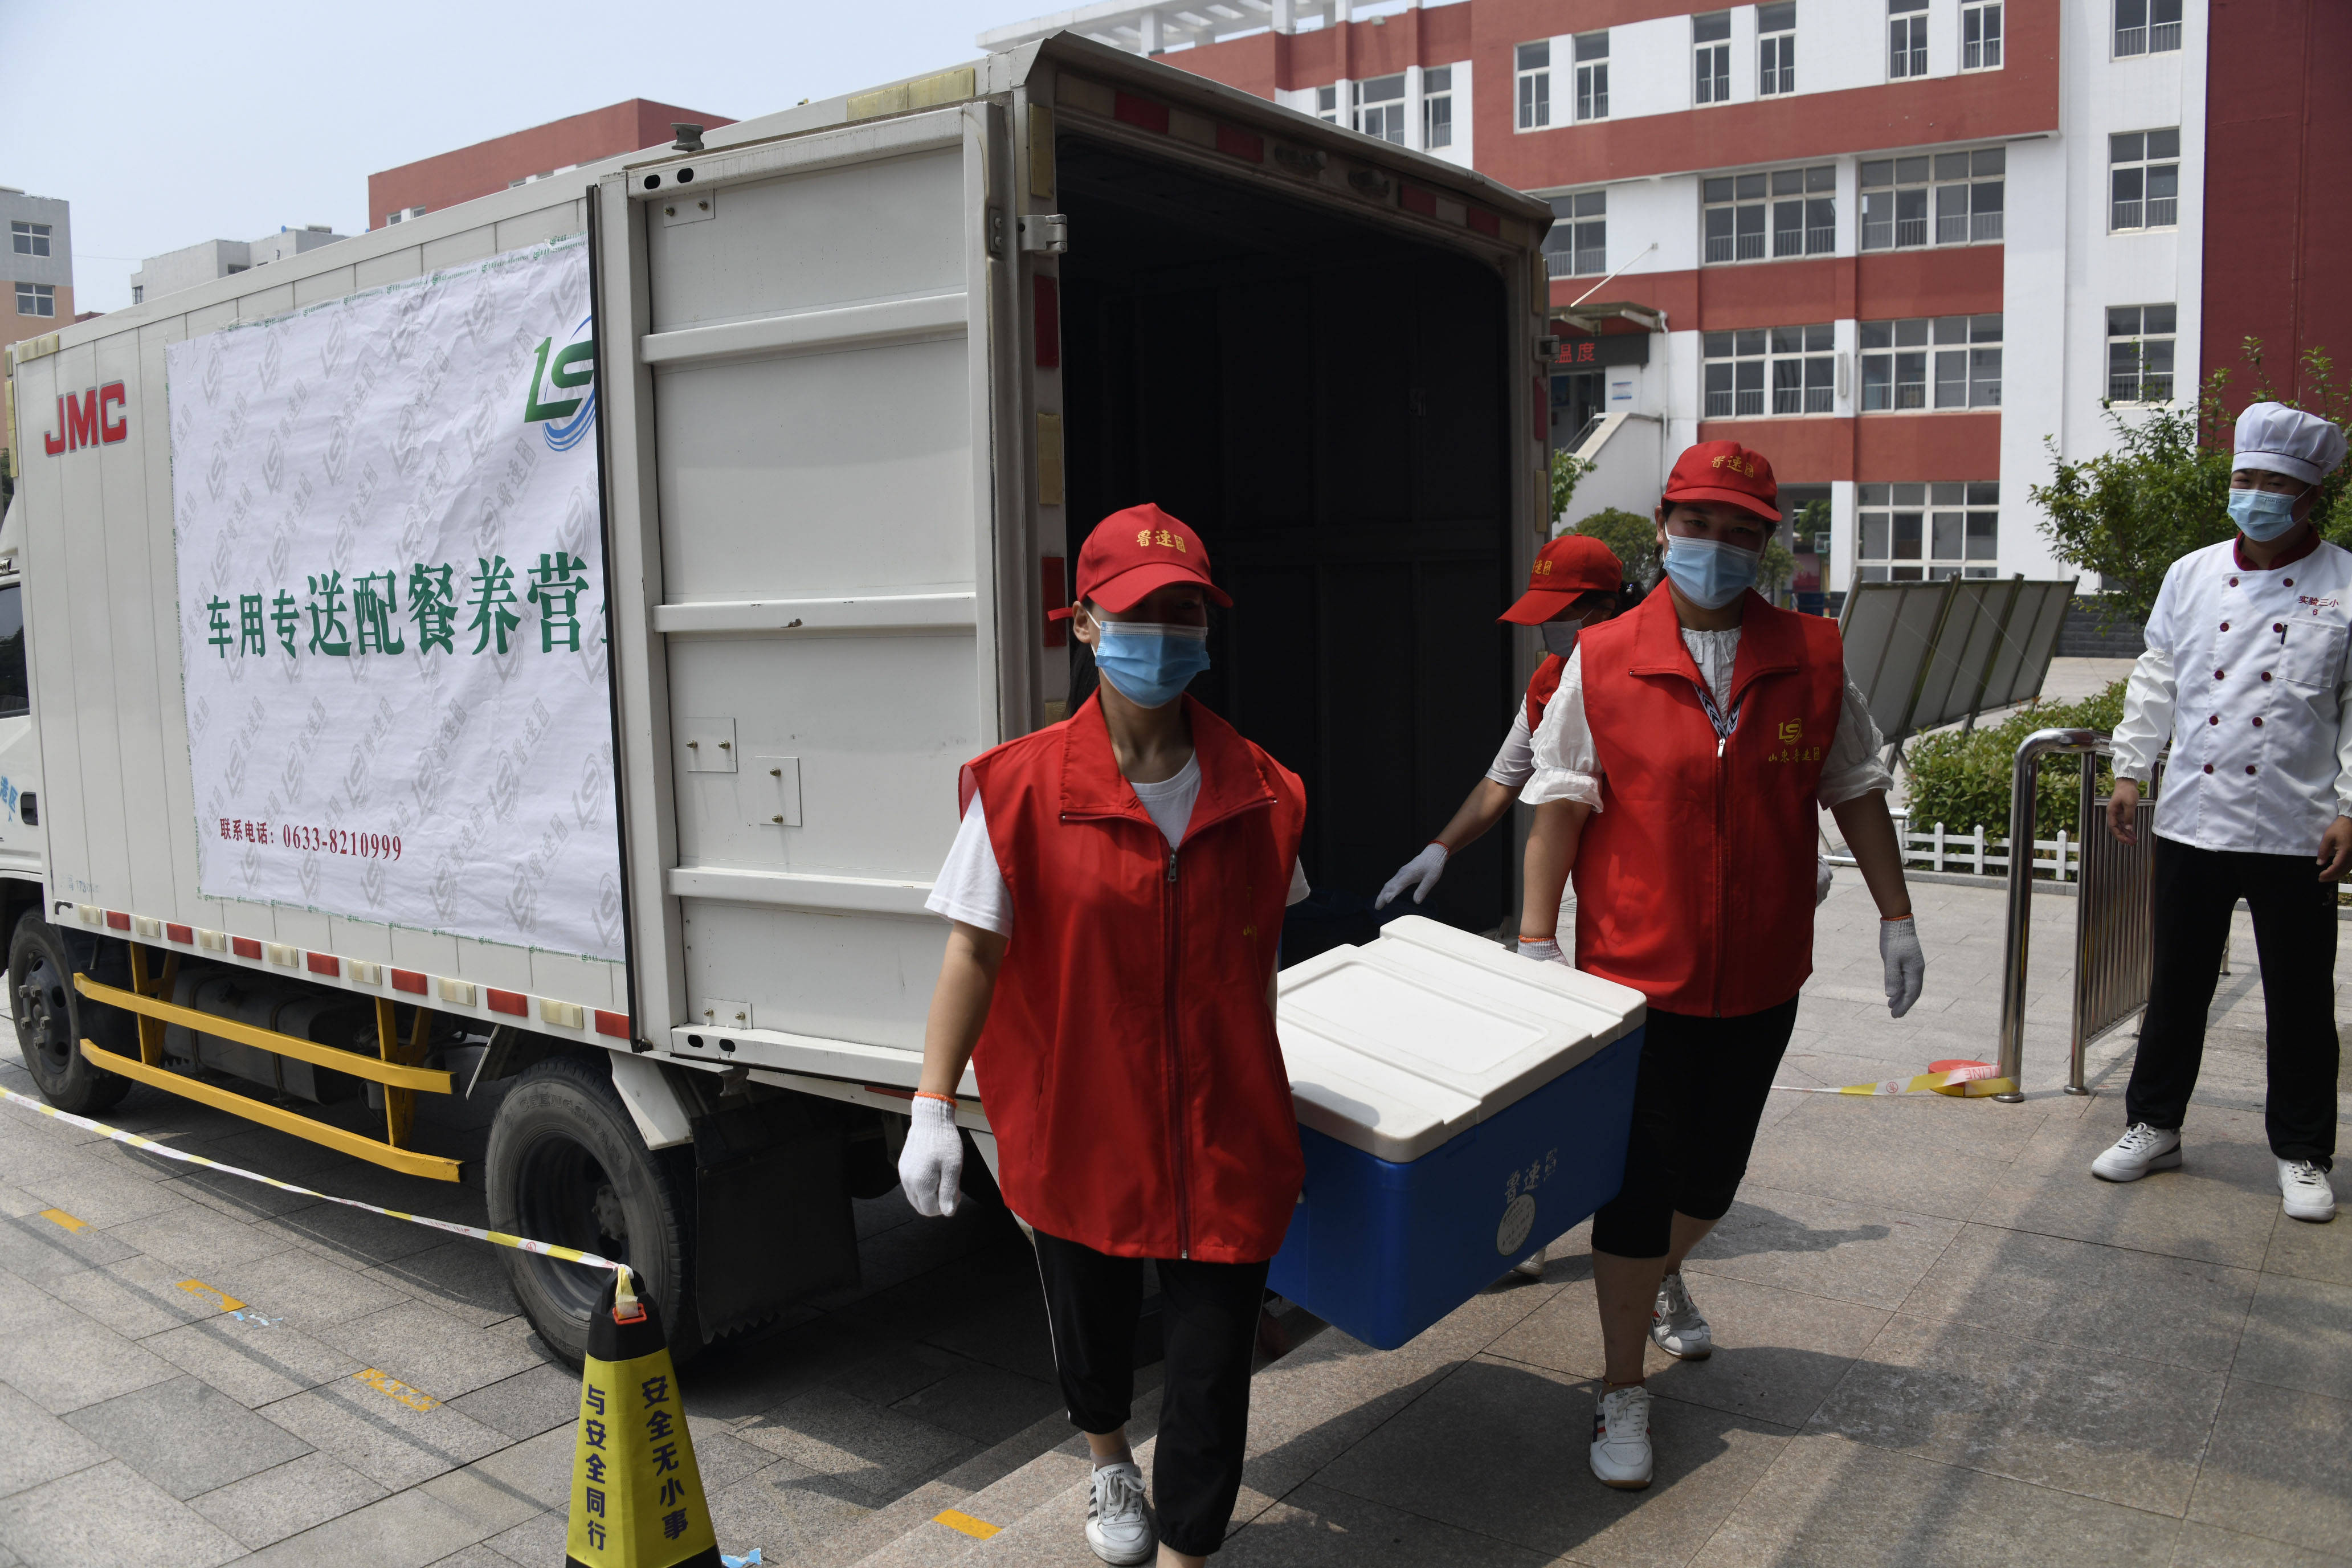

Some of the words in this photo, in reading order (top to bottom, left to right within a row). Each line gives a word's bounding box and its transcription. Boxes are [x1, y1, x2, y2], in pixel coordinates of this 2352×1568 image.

[1555, 342, 1595, 363] 温度
[44, 379, 127, 458] JMC
[2298, 595, 2339, 607] 实验三小
[283, 824, 401, 861] 0633-8210999
[586, 1383, 606, 1551] 与安全同行
[642, 1375, 688, 1540] 安全无小事
